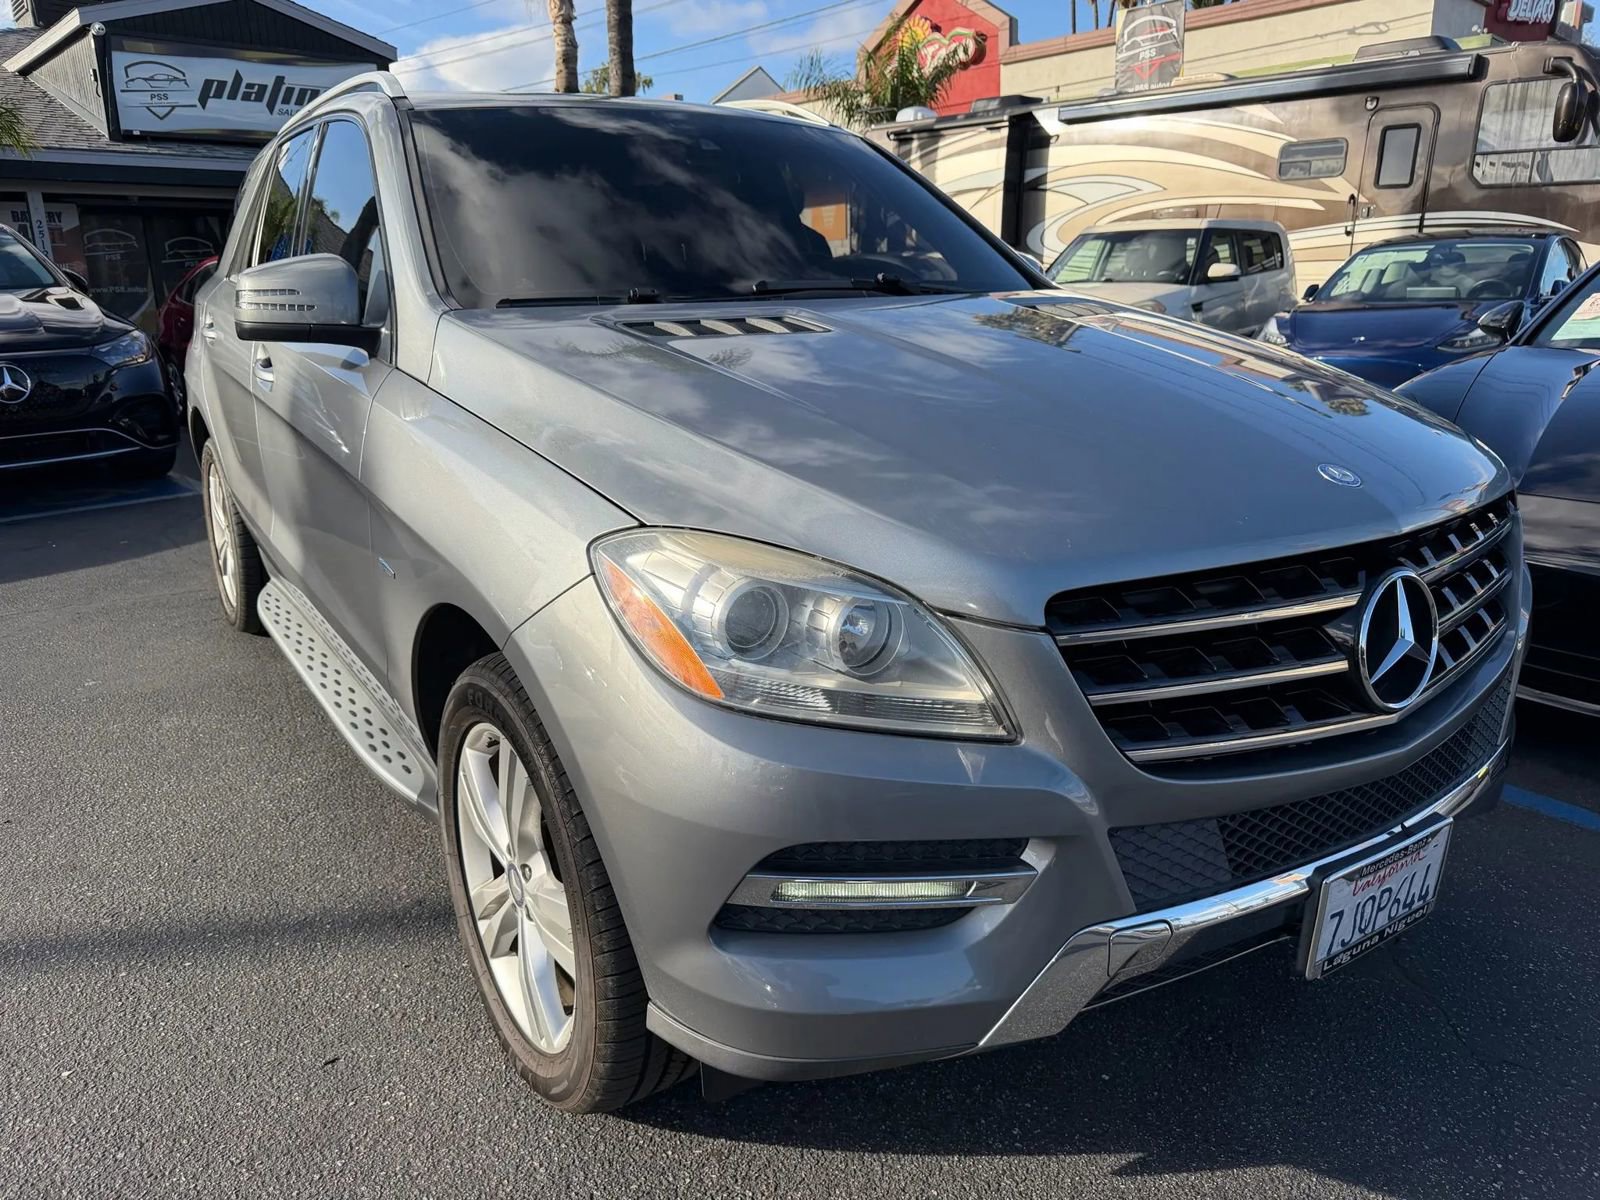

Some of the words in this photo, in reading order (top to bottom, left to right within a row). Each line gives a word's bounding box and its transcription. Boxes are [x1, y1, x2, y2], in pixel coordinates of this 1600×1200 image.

[150, 93, 169, 101] PSS
[198, 69, 322, 116] platin
[277, 107, 301, 116] SAL
[1353, 851, 1428, 897] California
[1361, 838, 1429, 877] Mercedes-Benz
[1326, 862, 1432, 957] 7JQP644
[1323, 935, 1380, 971] Laguna
[1384, 904, 1428, 938] Niguel
